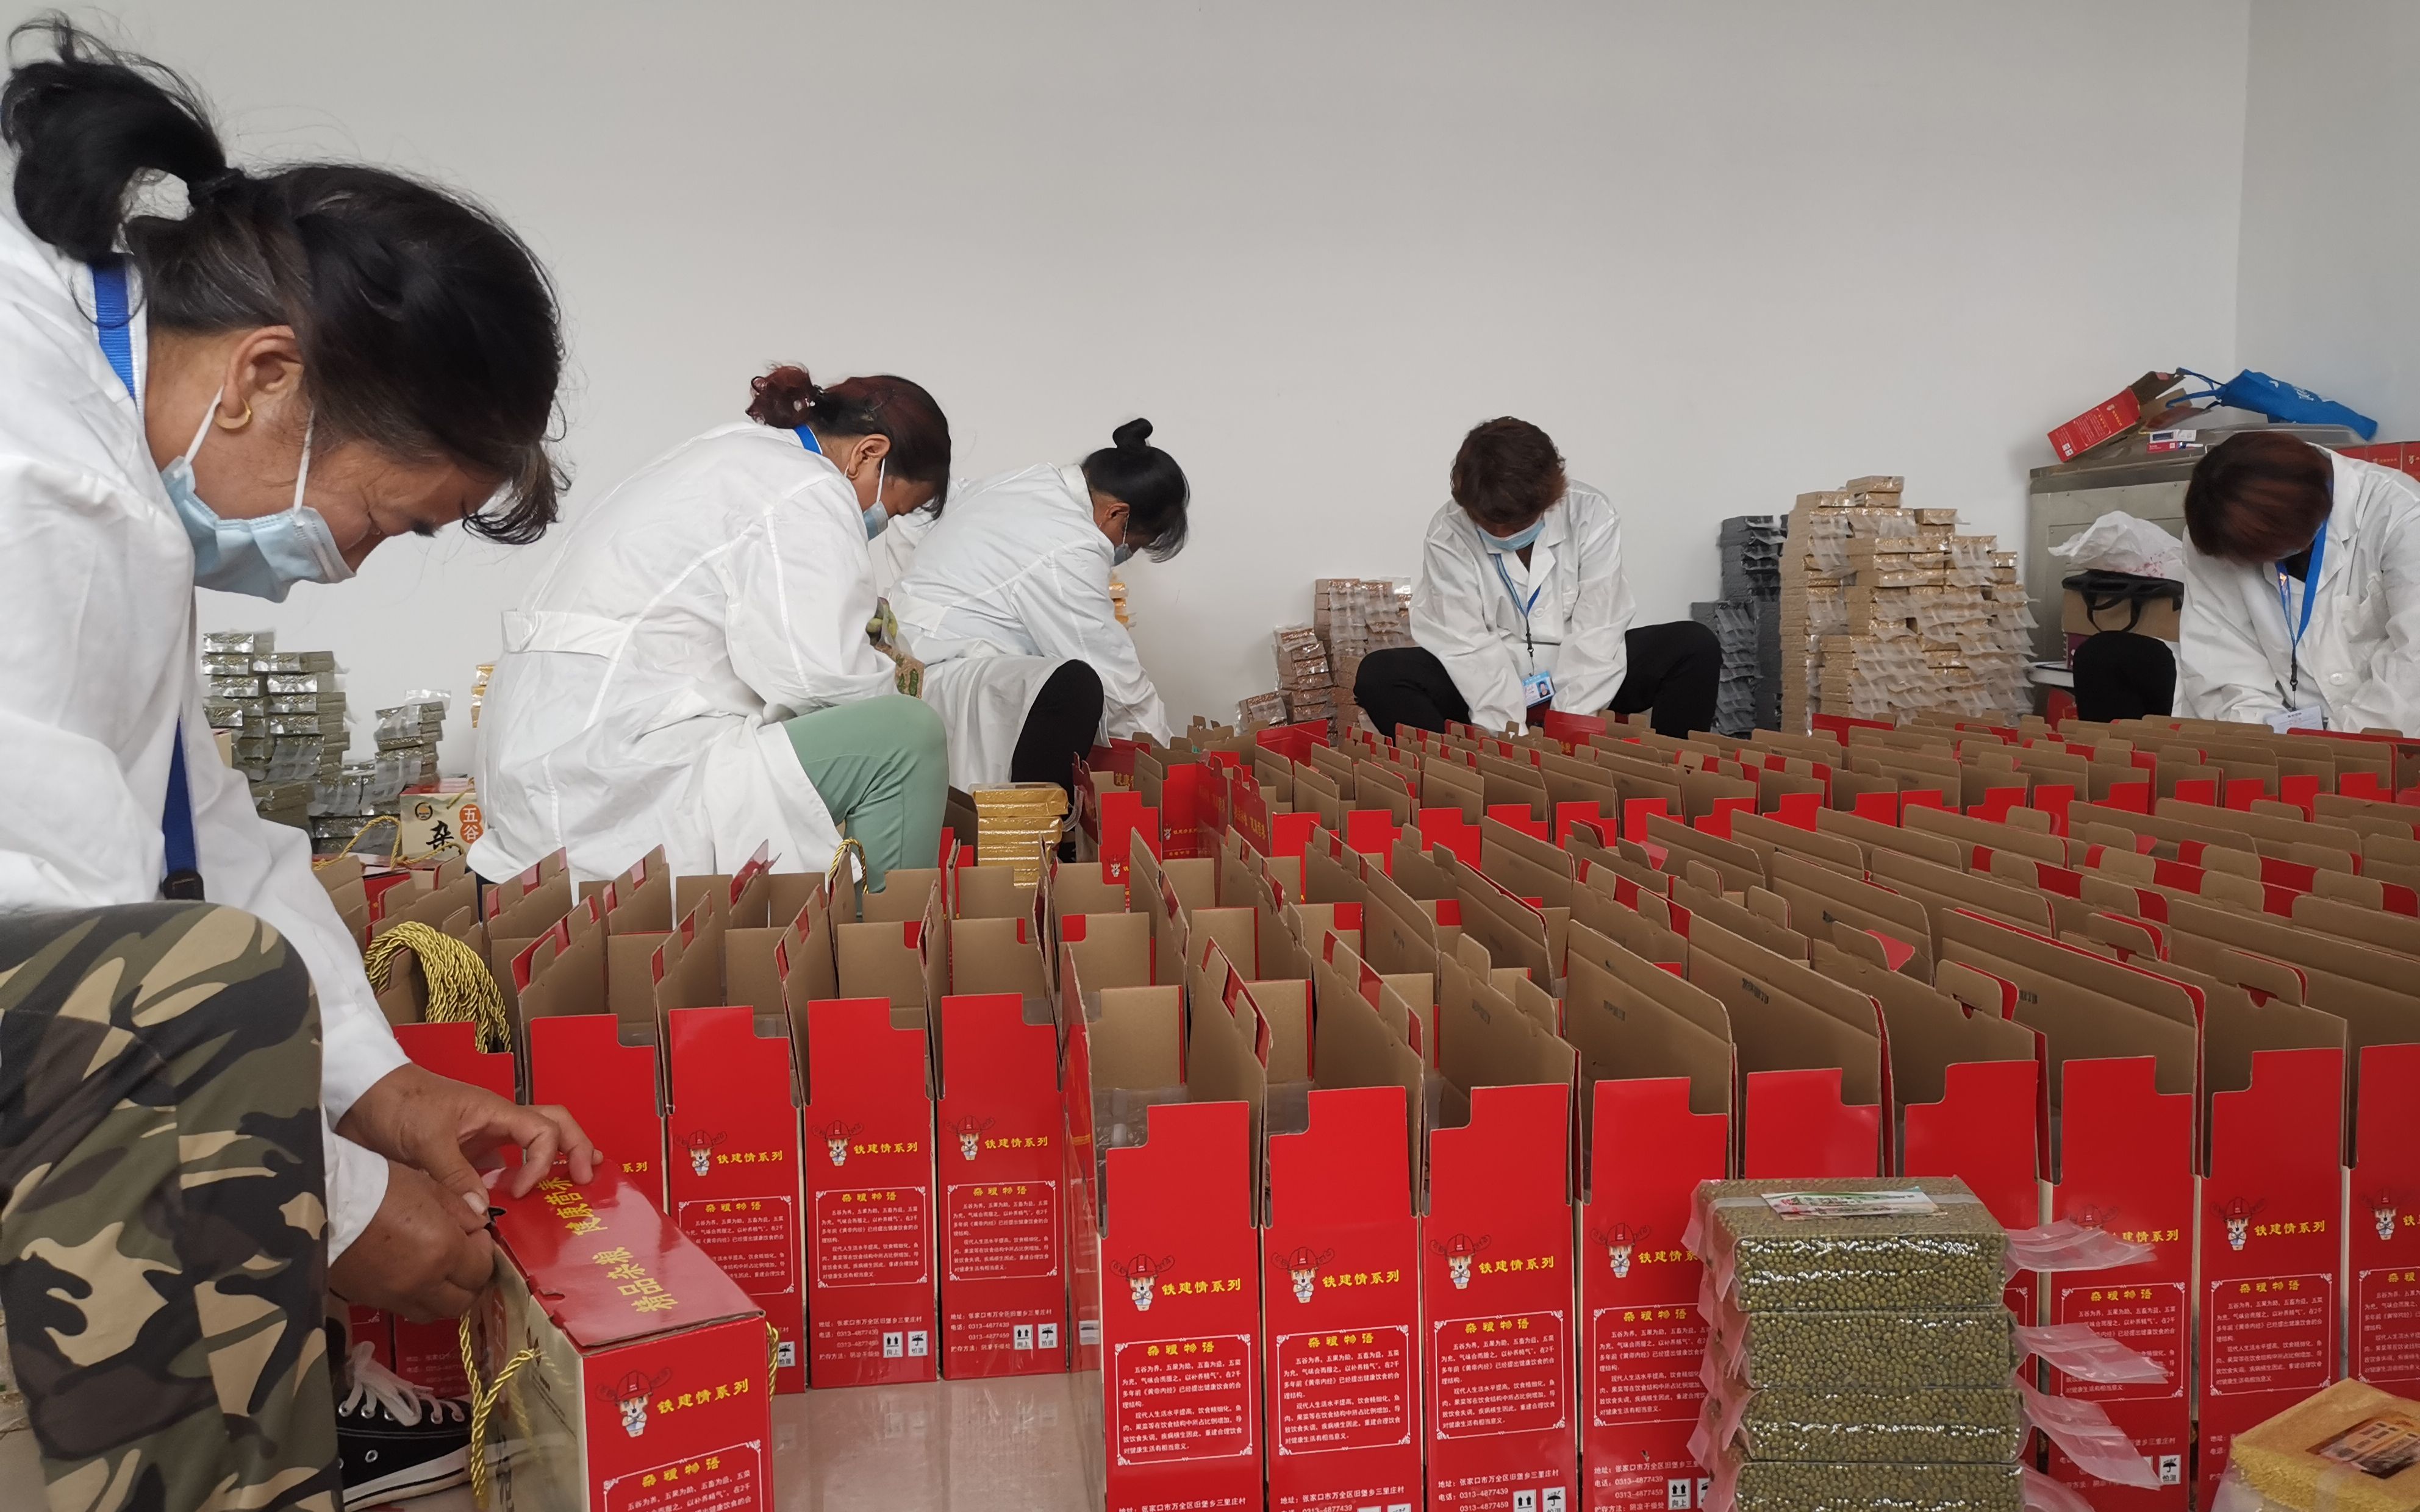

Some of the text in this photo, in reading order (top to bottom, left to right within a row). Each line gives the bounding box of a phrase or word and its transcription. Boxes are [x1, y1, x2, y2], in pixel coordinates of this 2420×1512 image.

[463, 807, 479, 841] 五谷
[426, 820, 454, 852] 杂
[853, 1141, 918, 1155] 铁建情系列
[984, 1136, 1048, 1149] 铁建情系列
[717, 1151, 782, 1164] 铁建情系列
[617, 1161, 648, 1172] 系列
[2254, 1219, 2325, 1236] 铁建情系列
[2402, 1213, 2420, 1226] 铁
[2111, 1227, 2178, 1244] 建情系列
[1478, 1255, 1555, 1274] 铁建情系列
[593, 1247, 678, 1312] 精品杂粮
[1161, 1277, 1241, 1296] 铁建情系列
[1322, 1269, 1399, 1288] 铁建情系列
[657, 1378, 748, 1414] 铁建情系列
[1459, 1501, 1508, 1512] 0313-4877459
[1672, 1498, 1686, 1507] 向上
